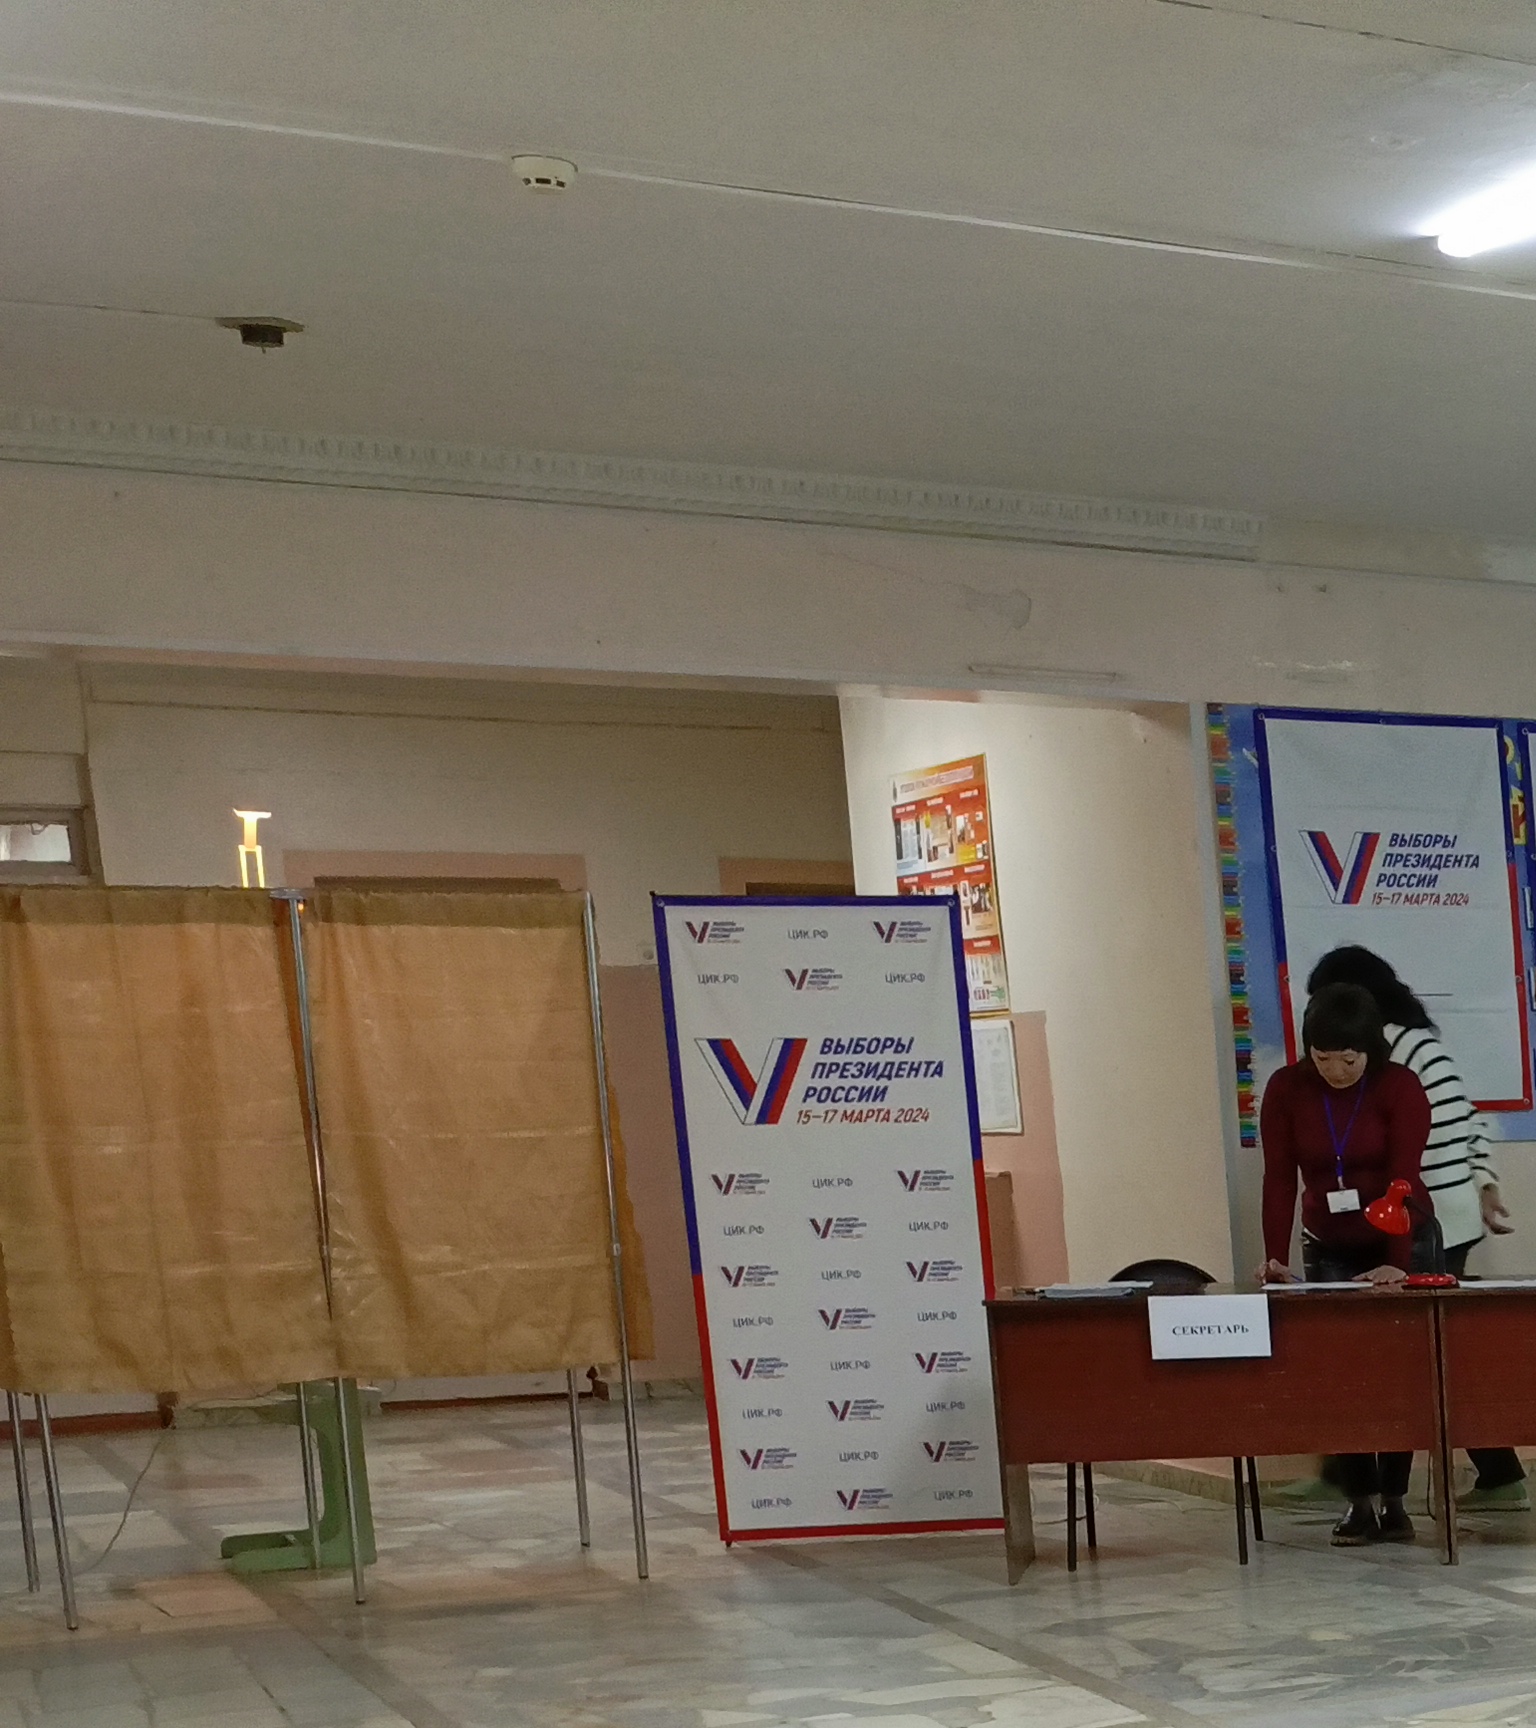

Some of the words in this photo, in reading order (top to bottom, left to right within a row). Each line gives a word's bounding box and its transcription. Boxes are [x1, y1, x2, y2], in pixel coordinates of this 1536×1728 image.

[1388, 832, 1458, 849] ВЫБОРЫ
[1381, 853, 1480, 871] ПРЕЗИДЕНТА
[1375, 872, 1439, 889] РОССИИ
[1403, 893, 1441, 906] МАРТА
[1442, 893, 1470, 906] 2024
[788, 929, 829, 940] ЦИК.РФ
[697, 974, 739, 985] ЦИК.РФ
[885, 973, 926, 984] ЦИК.РФ
[819, 1036, 914, 1056] ВЫБОРЫ
[810, 1060, 945, 1082] ПРЕЗИДЕНТА
[802, 1085, 889, 1104] РОССИИ
[840, 1109, 891, 1124] МАРТА
[894, 1108, 930, 1123] 2024
[812, 1178, 853, 1188] ЦИК.РФ
[724, 1225, 764, 1236] ЦИК.РФ
[909, 1221, 949, 1232] ЦИК.РФ
[821, 1269, 862, 1281] ЦИК.РФ
[918, 1311, 957, 1322] ЦИК.РФ
[1172, 1324, 1250, 1336] СЕКРЕТАРЬ
[830, 1360, 870, 1372] ЦИК.РФ
